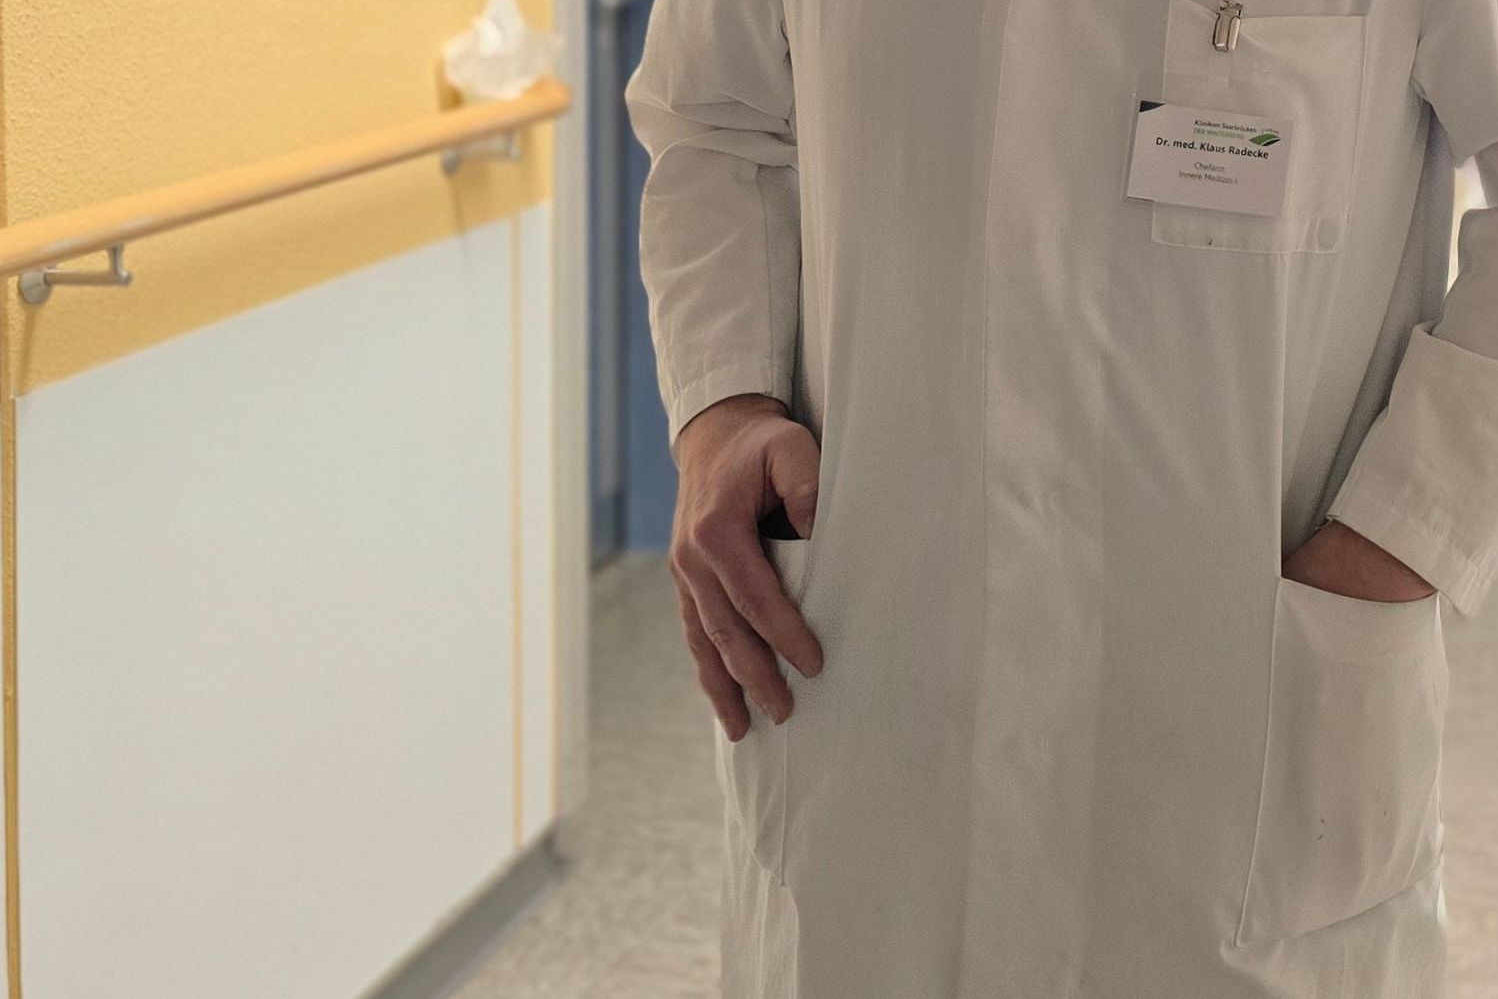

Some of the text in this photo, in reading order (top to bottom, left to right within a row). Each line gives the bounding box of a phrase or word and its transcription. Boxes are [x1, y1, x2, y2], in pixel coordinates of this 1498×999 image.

[1156, 137, 1269, 159] Dr. med. Klaus Radecke
